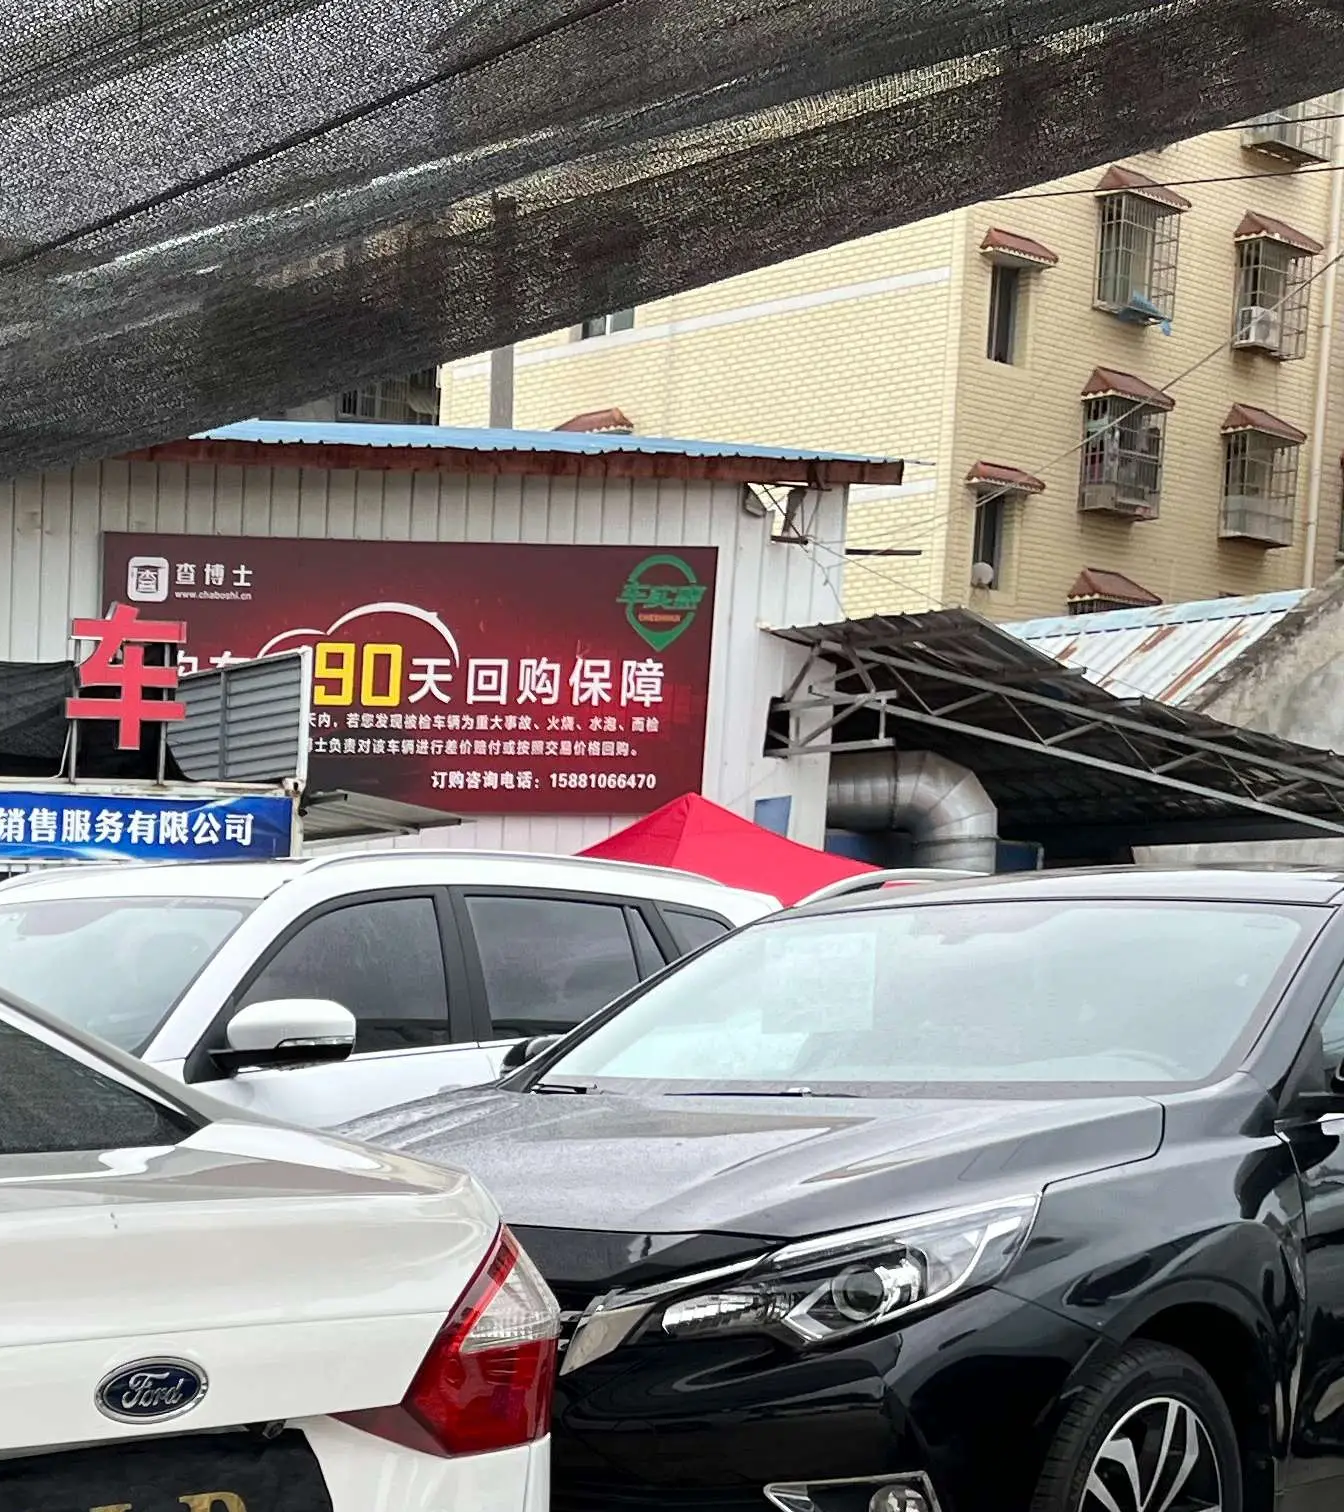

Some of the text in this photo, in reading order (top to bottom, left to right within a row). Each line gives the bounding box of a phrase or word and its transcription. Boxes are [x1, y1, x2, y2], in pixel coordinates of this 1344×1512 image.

[175, 562, 253, 587] 查博士
[174, 590, 252, 601] www.chaboshi.cn
[121, 1371, 185, 1409] Ford
